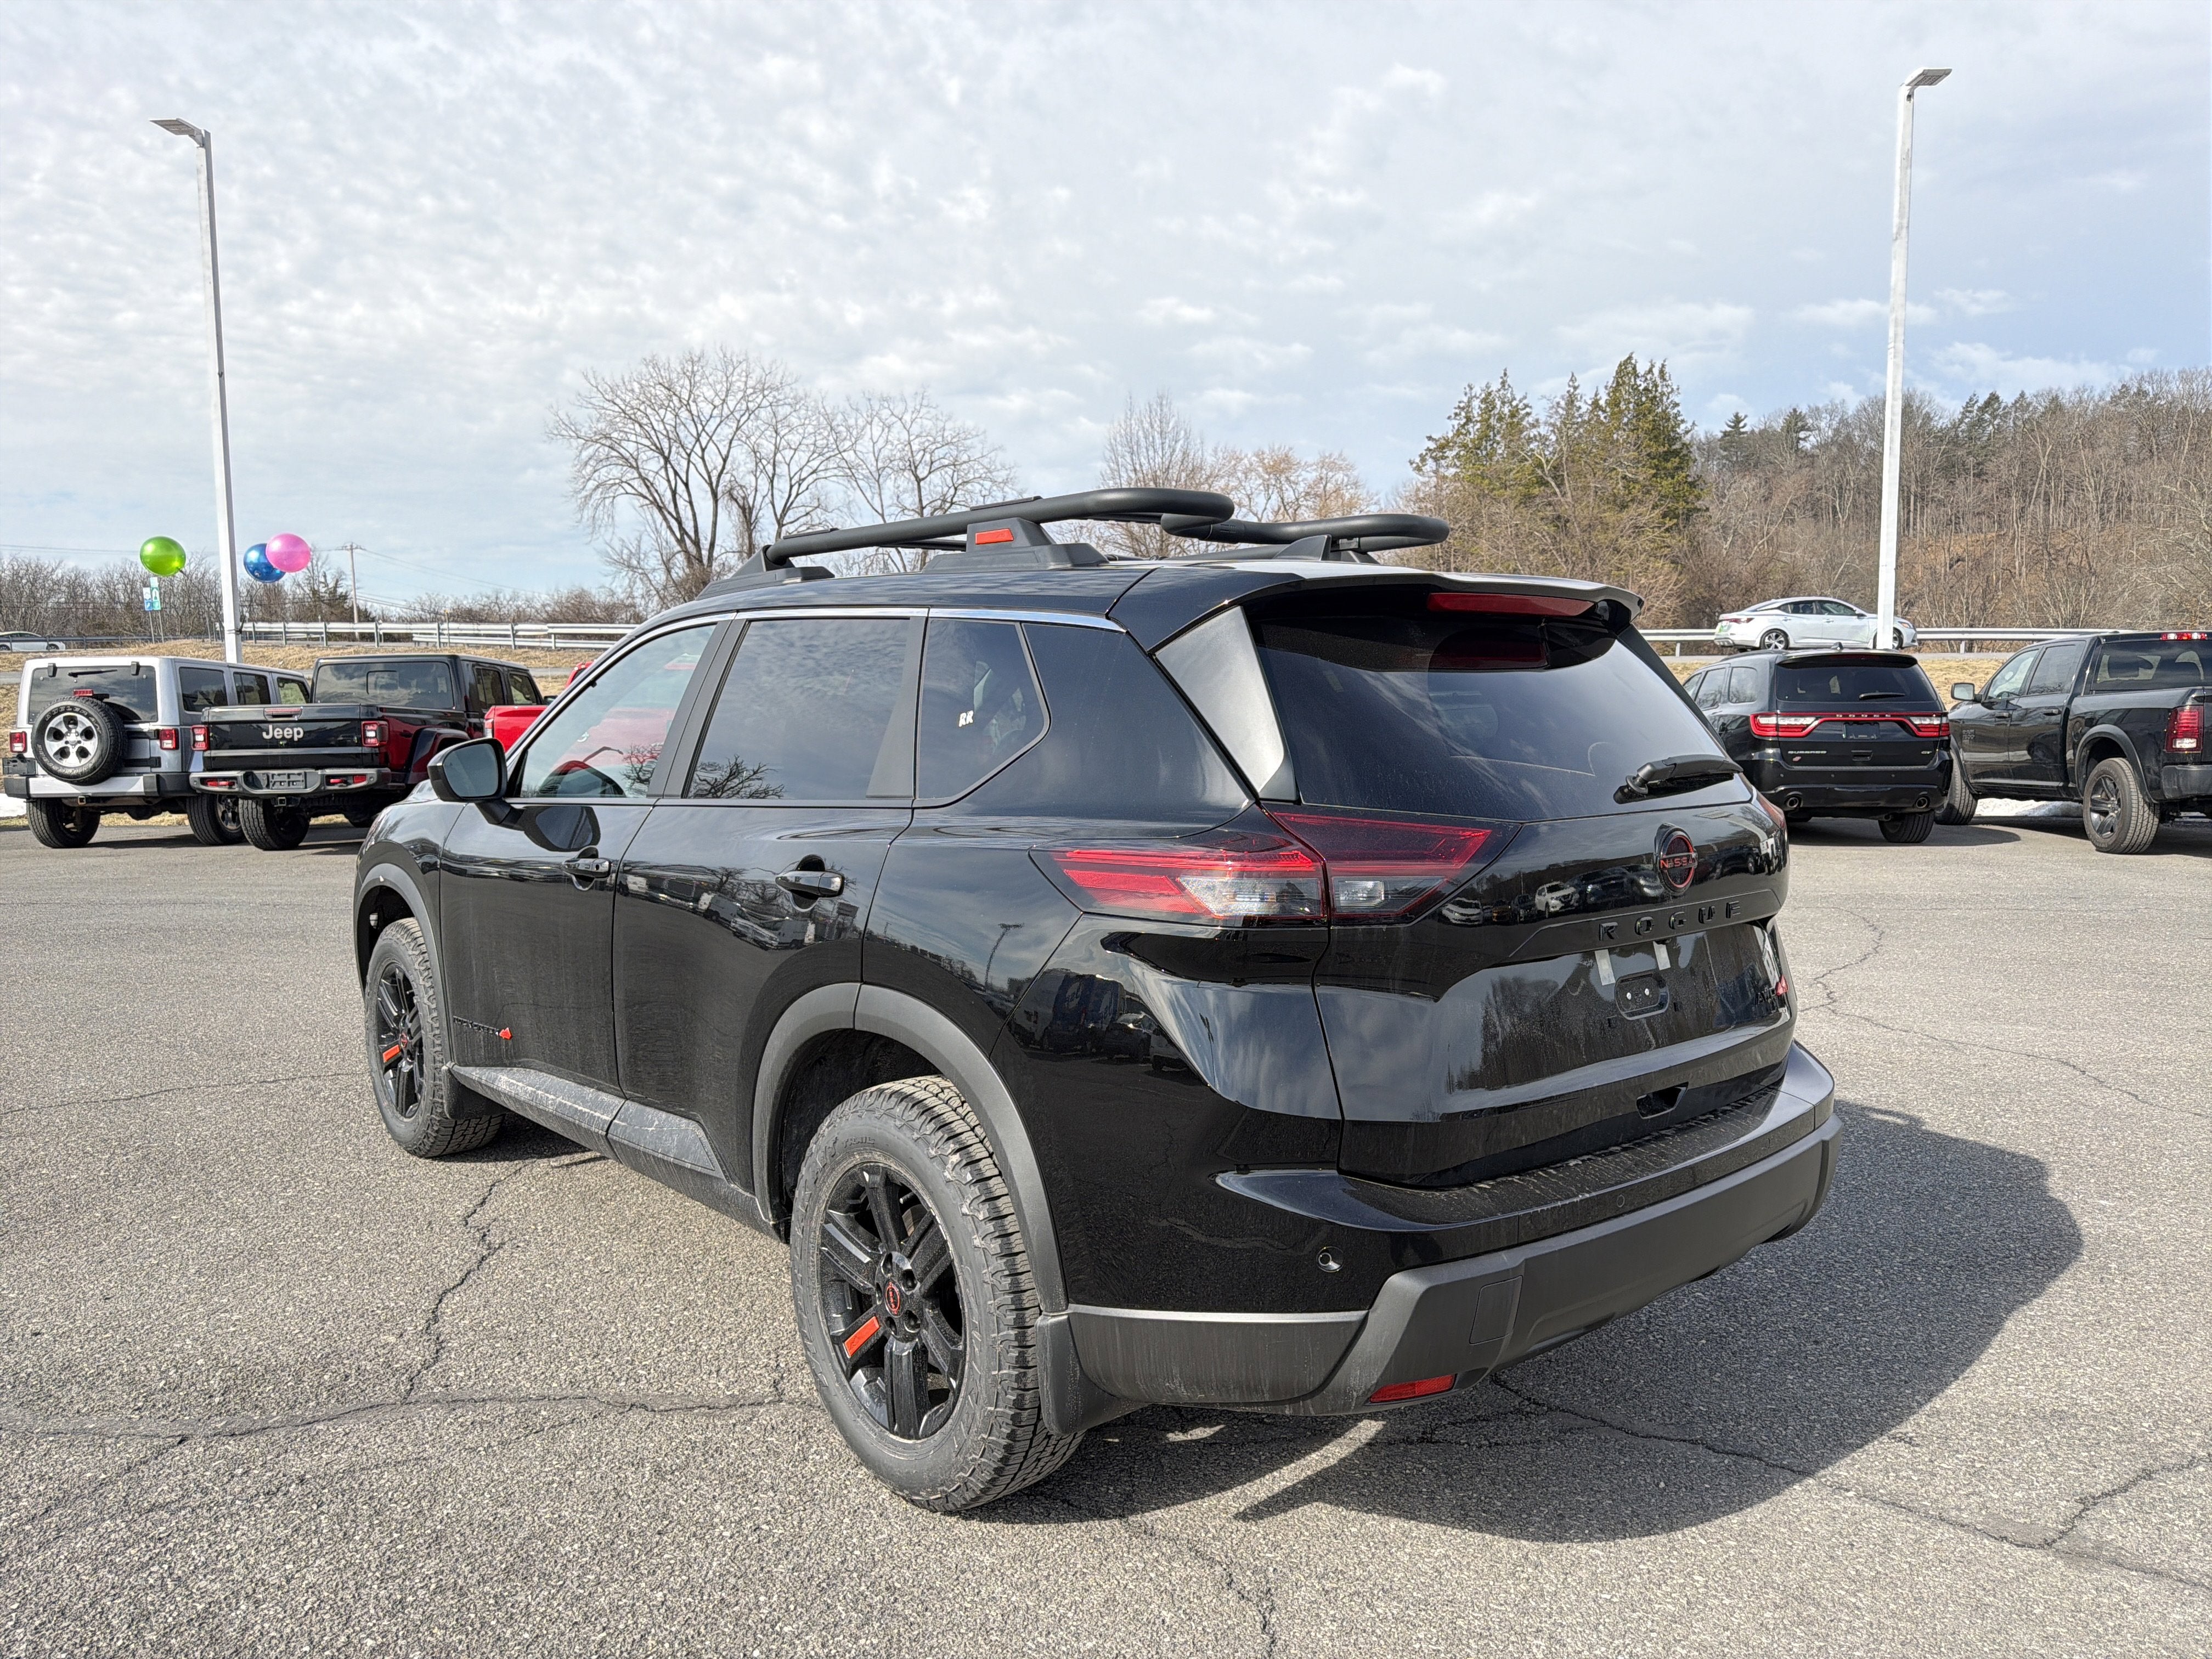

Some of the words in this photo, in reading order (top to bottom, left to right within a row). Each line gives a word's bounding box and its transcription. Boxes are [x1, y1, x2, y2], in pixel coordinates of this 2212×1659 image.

[958, 710, 974, 727] RR
[262, 724, 303, 741] Jeep
[1599, 900, 1741, 941] ROGUE
